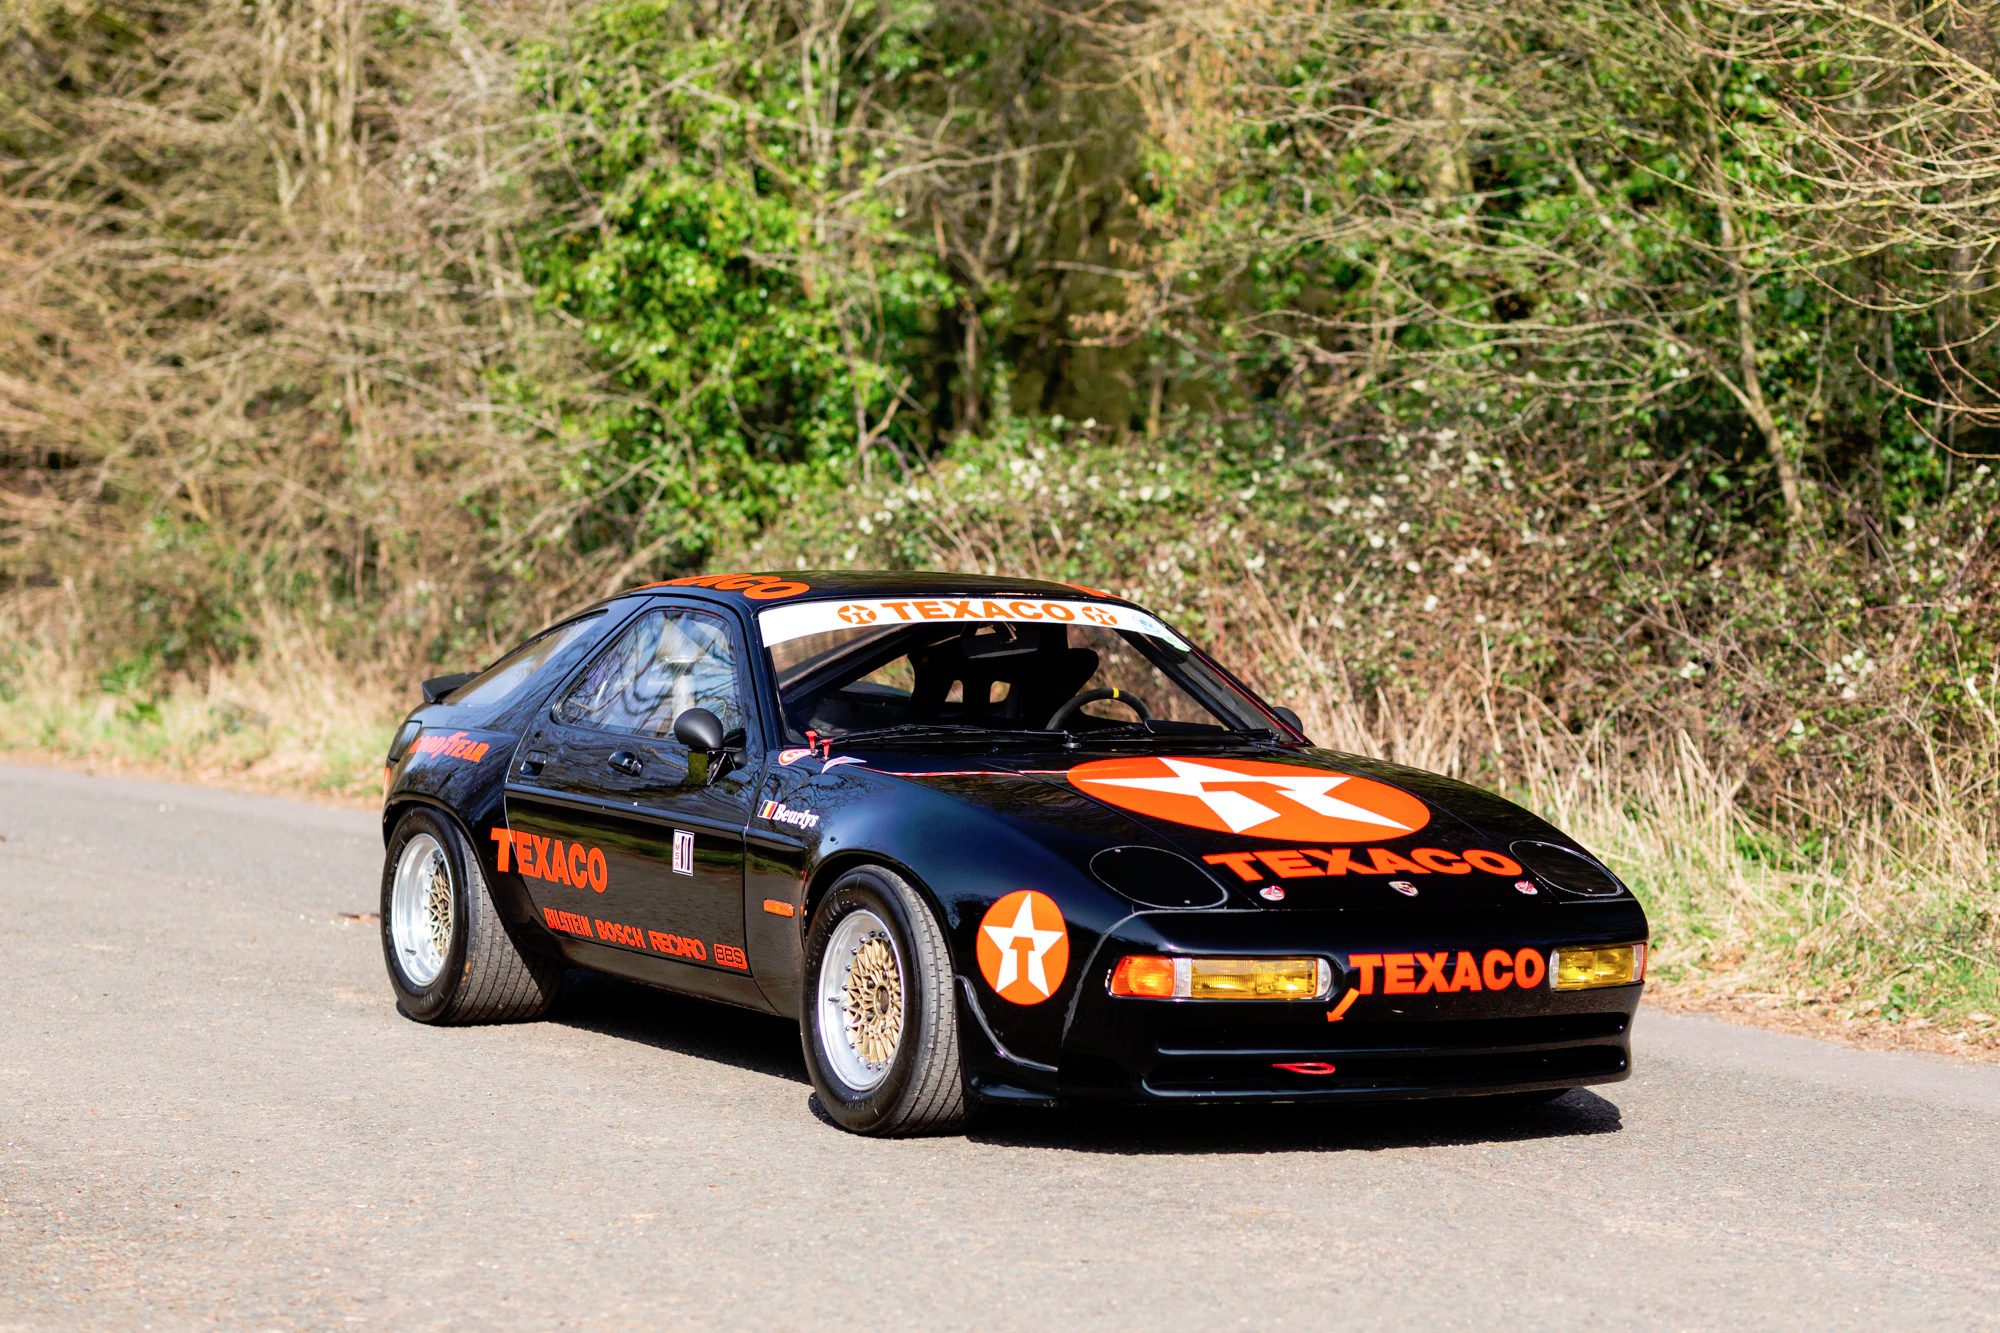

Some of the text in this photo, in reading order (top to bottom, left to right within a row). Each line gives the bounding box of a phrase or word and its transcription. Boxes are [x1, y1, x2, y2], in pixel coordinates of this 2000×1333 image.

[880, 601, 1075, 622] TEXACO
[491, 828, 608, 894] TEXACO
[1202, 848, 1523, 883] TEXACO
[543, 907, 745, 966] BILSTEIN BOSCH RECARO BBS
[1348, 948, 1546, 994] TEXACO
